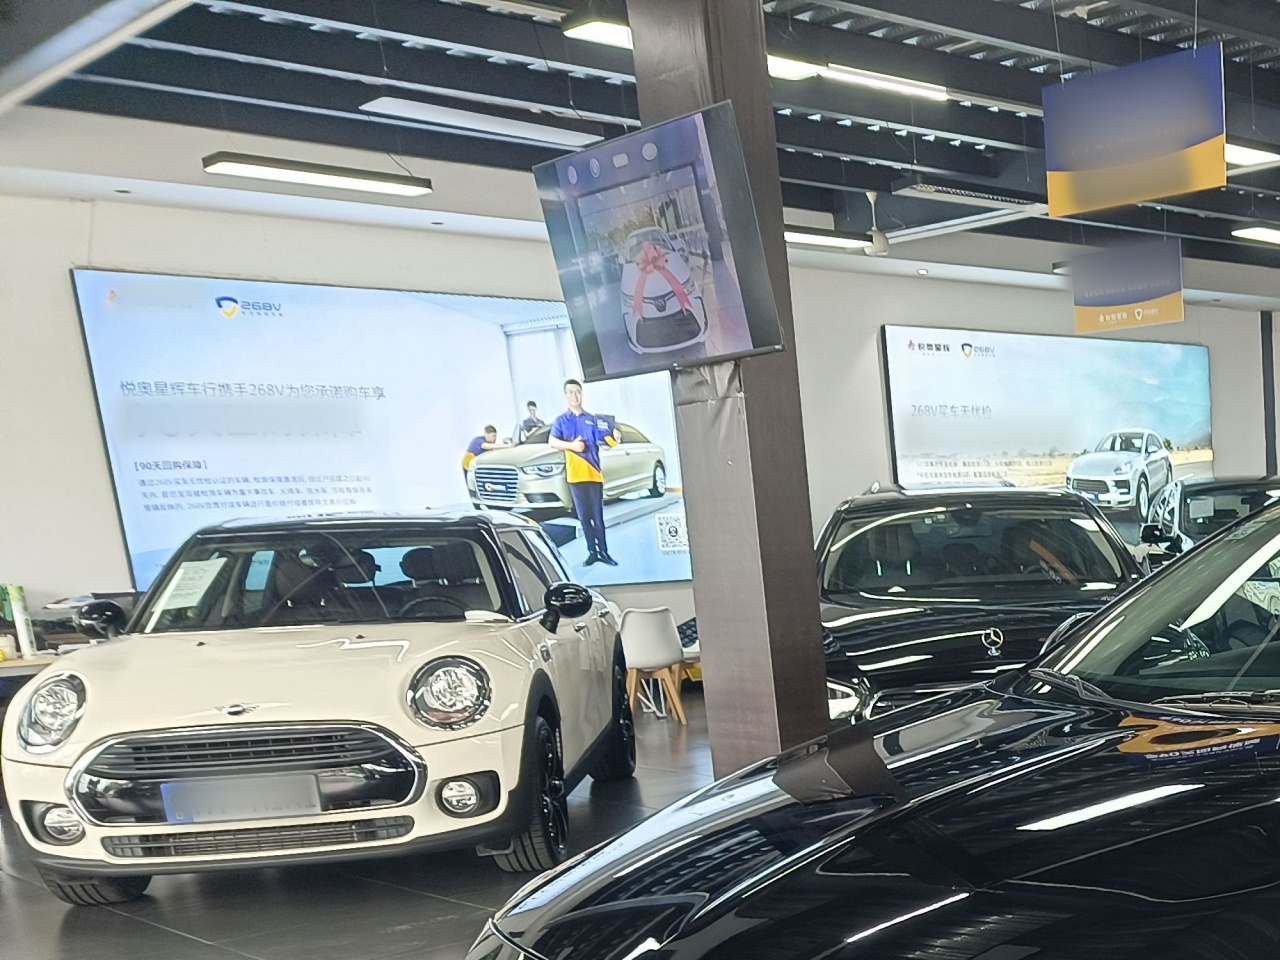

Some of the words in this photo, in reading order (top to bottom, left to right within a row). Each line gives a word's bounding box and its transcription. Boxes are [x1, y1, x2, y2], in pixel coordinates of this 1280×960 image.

[240, 300, 281, 311] 268V
[120, 380, 386, 400] 悦奥星辉车行携手268V为您承诺购车享
[911, 404, 992, 419] 268V买车无忧检
